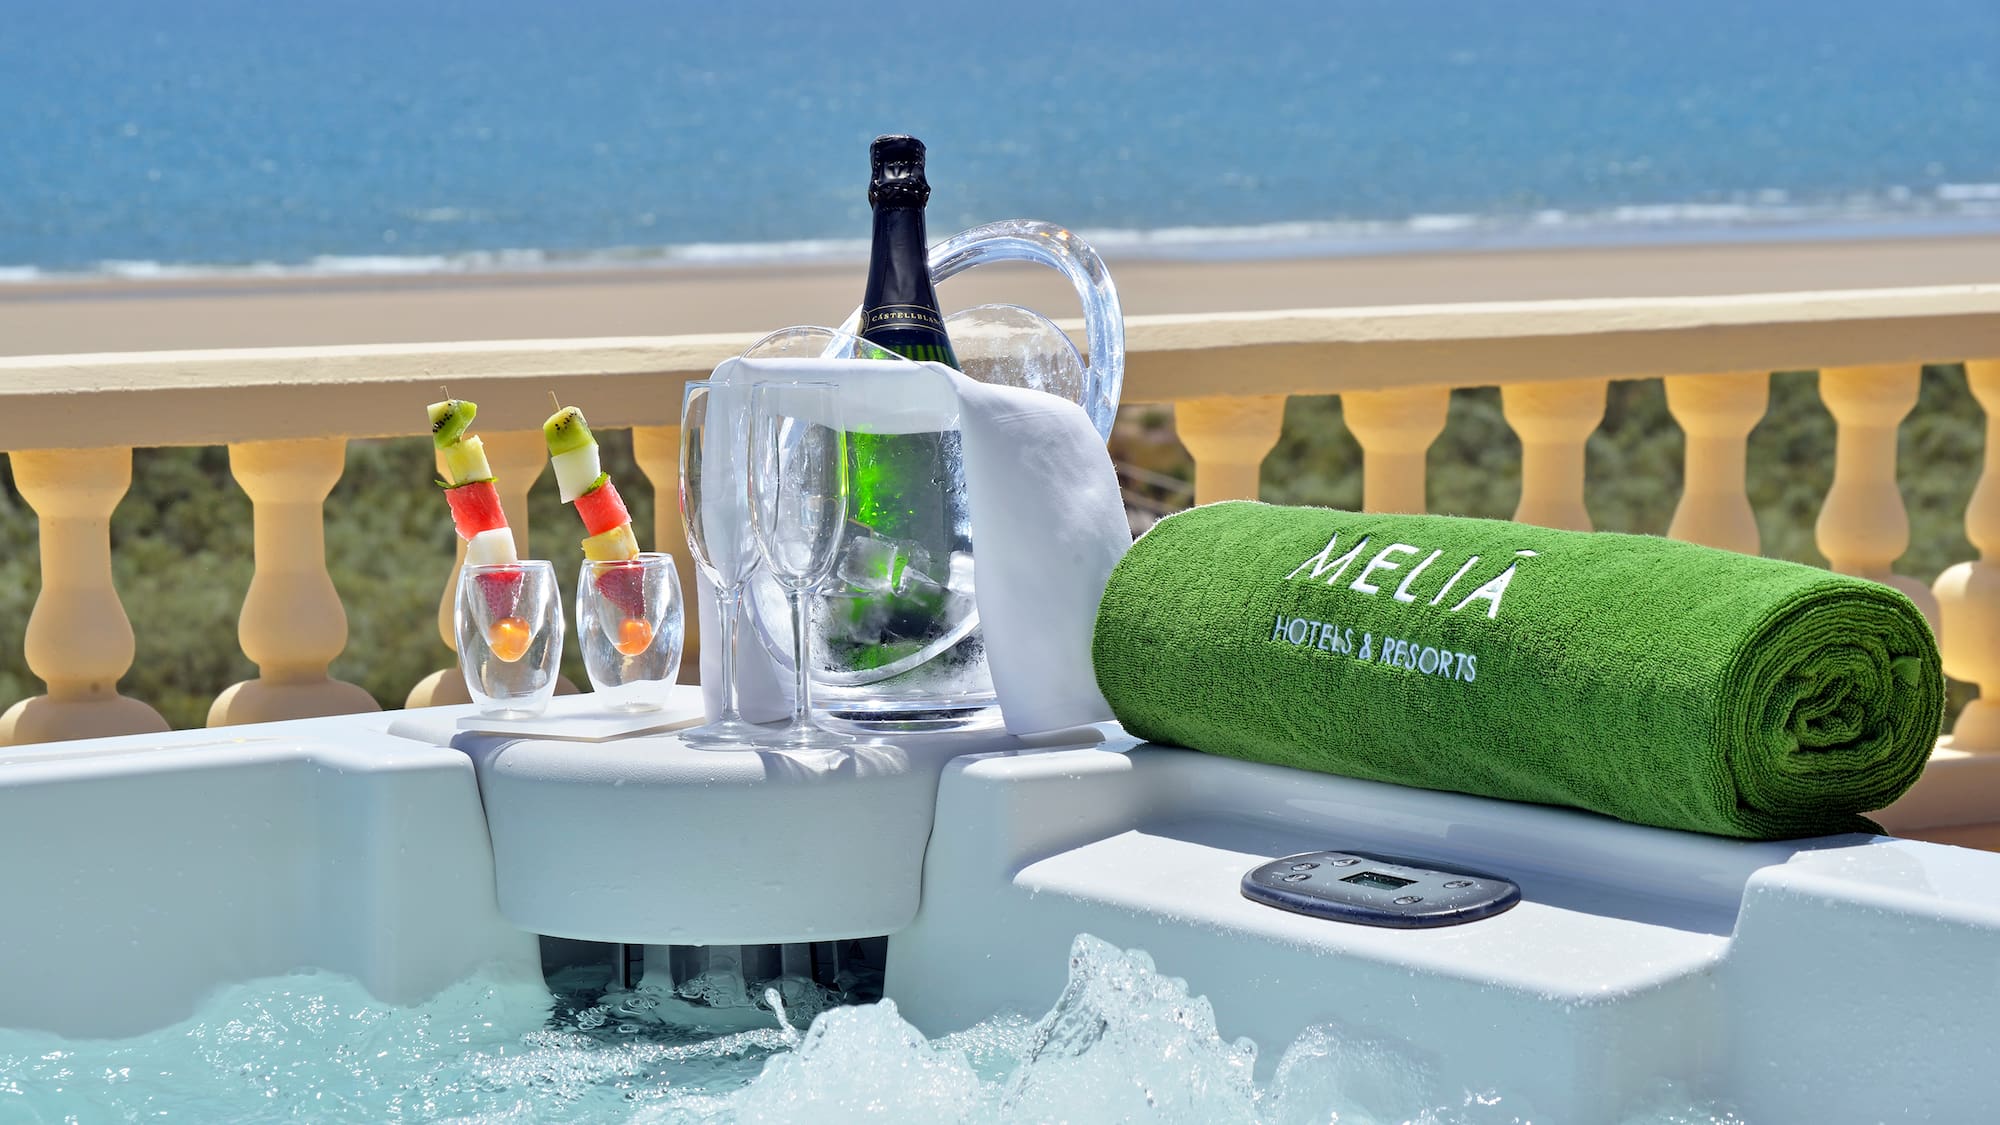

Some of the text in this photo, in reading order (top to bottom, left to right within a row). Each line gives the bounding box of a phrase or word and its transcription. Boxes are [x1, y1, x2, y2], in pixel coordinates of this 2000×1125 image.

[1285, 532, 1540, 619] MELIÁ
[1272, 615, 1477, 683] HOTELS & RESORTS
